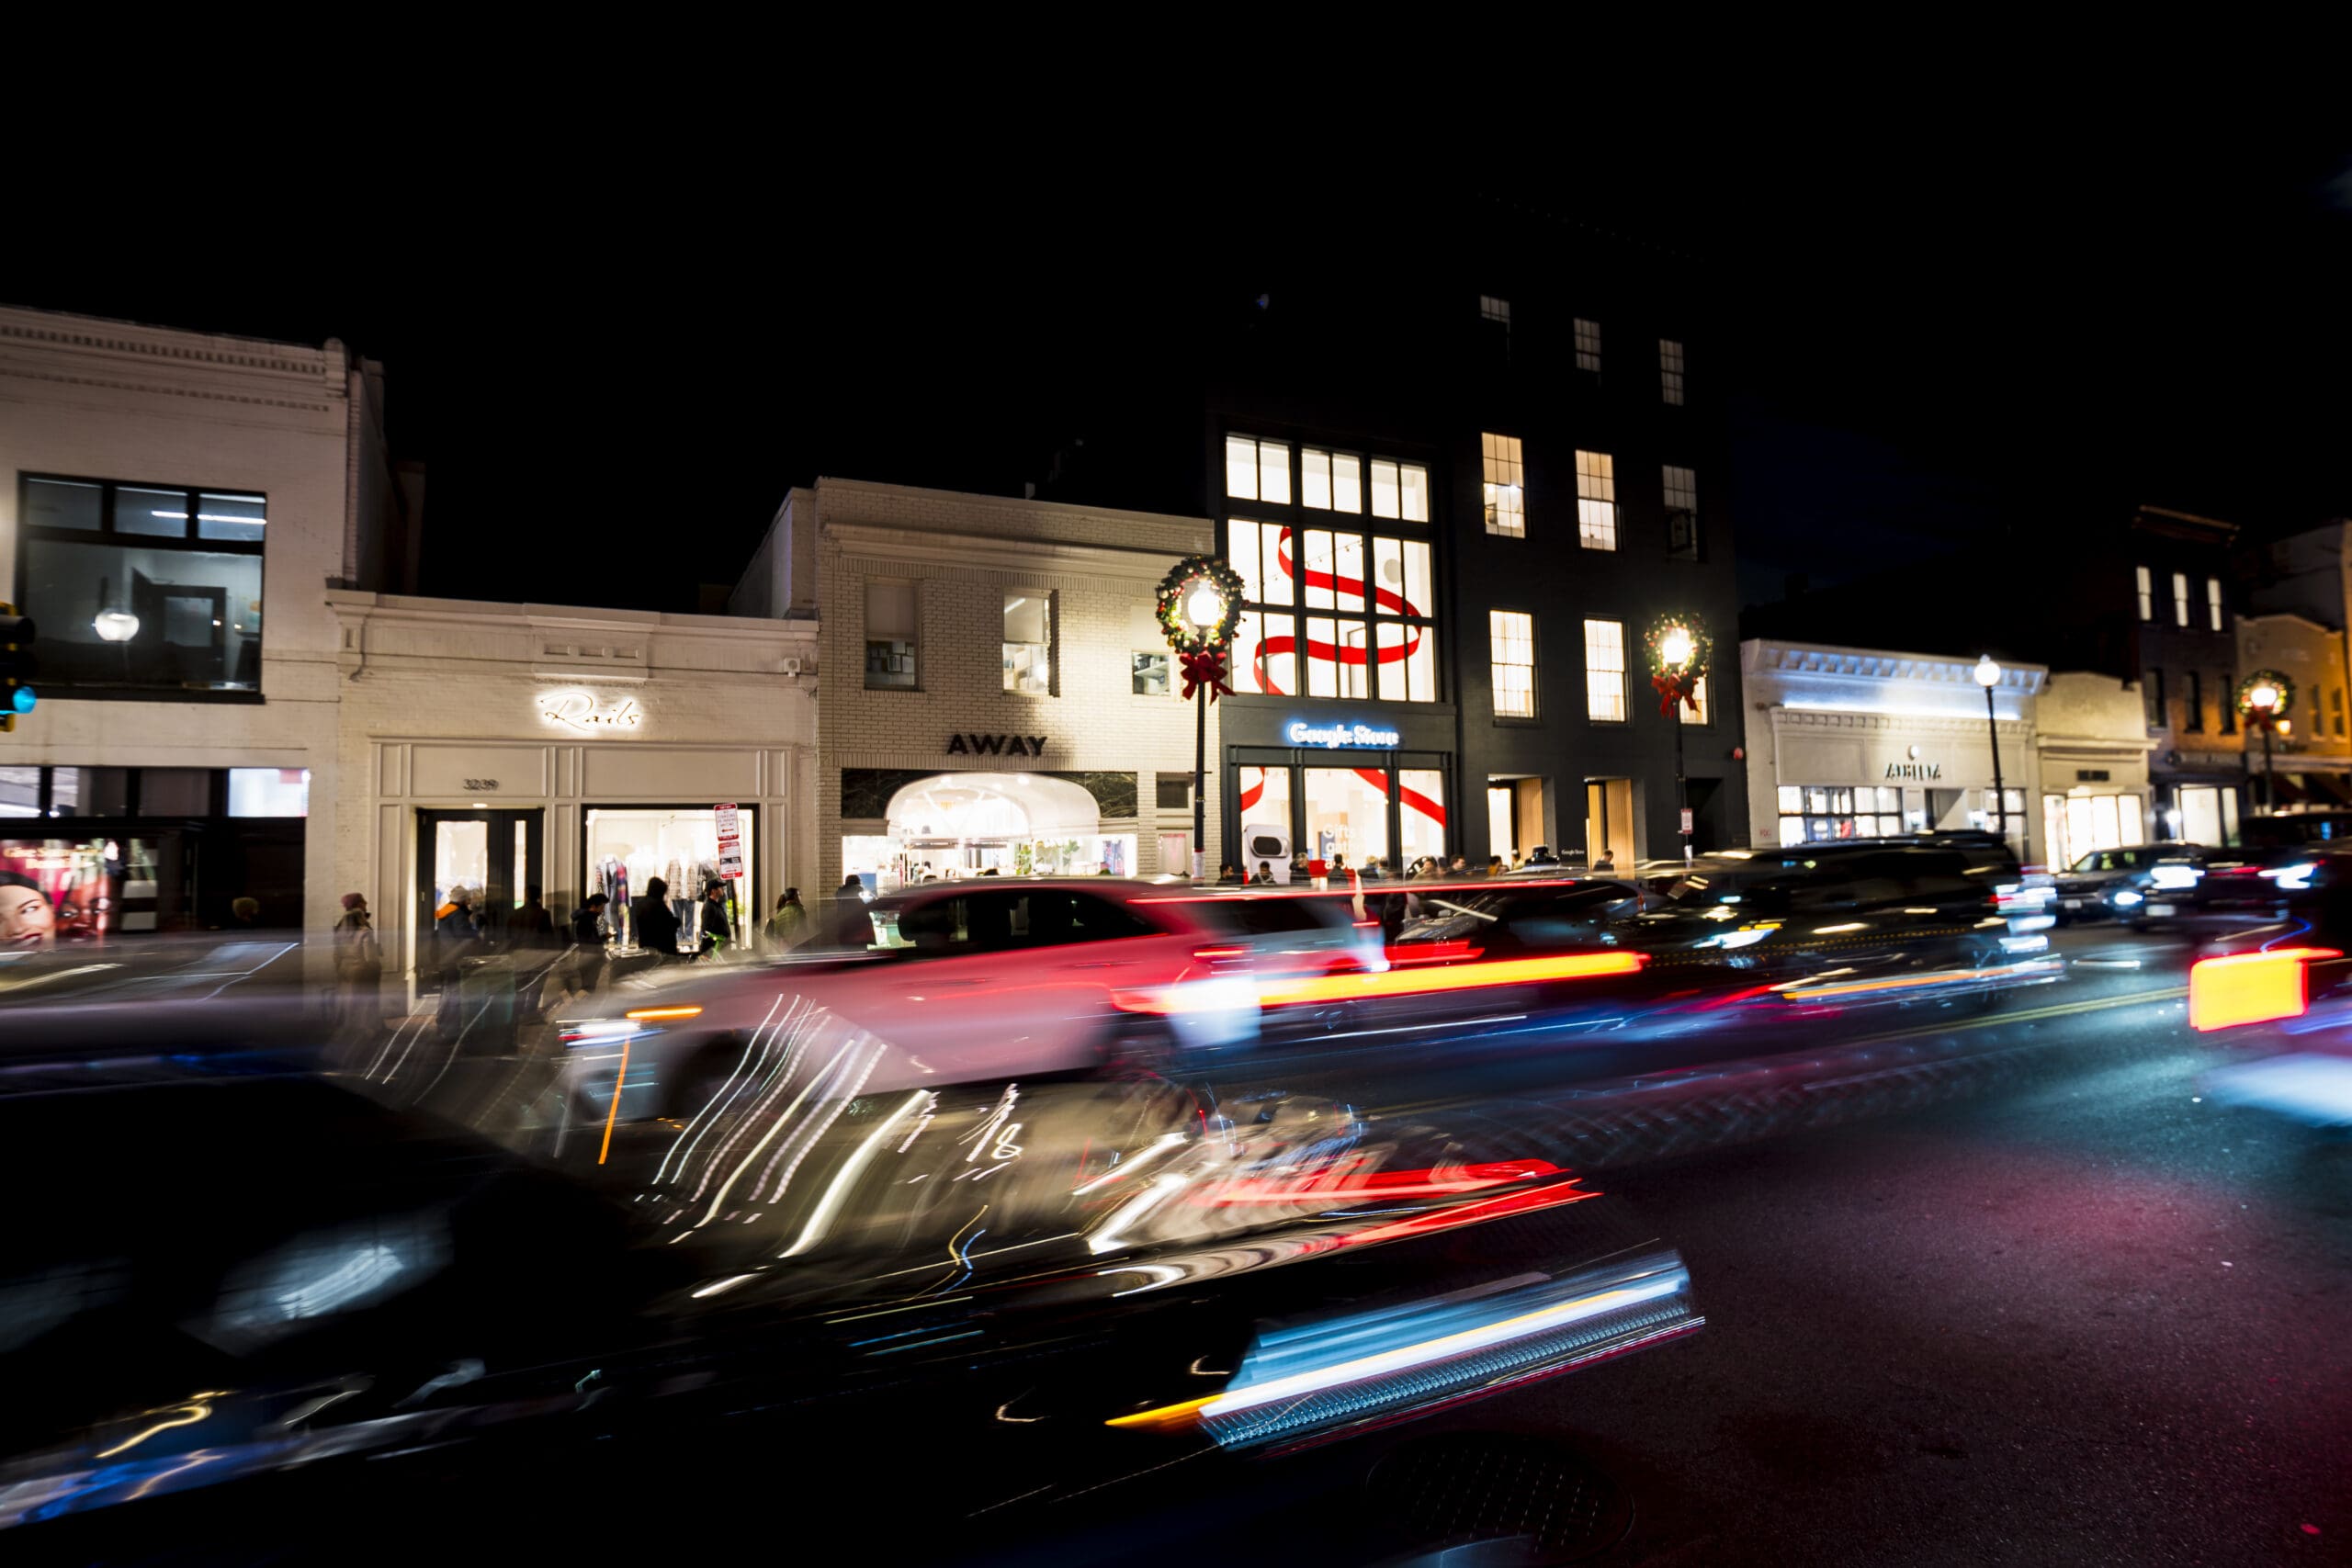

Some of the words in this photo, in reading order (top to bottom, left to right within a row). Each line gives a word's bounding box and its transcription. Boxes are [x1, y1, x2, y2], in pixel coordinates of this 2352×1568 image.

[539, 692, 640, 731] Rails
[946, 734, 1047, 756] AWAY
[1289, 722, 1353, 749] Google
[1354, 725, 1399, 746] Store
